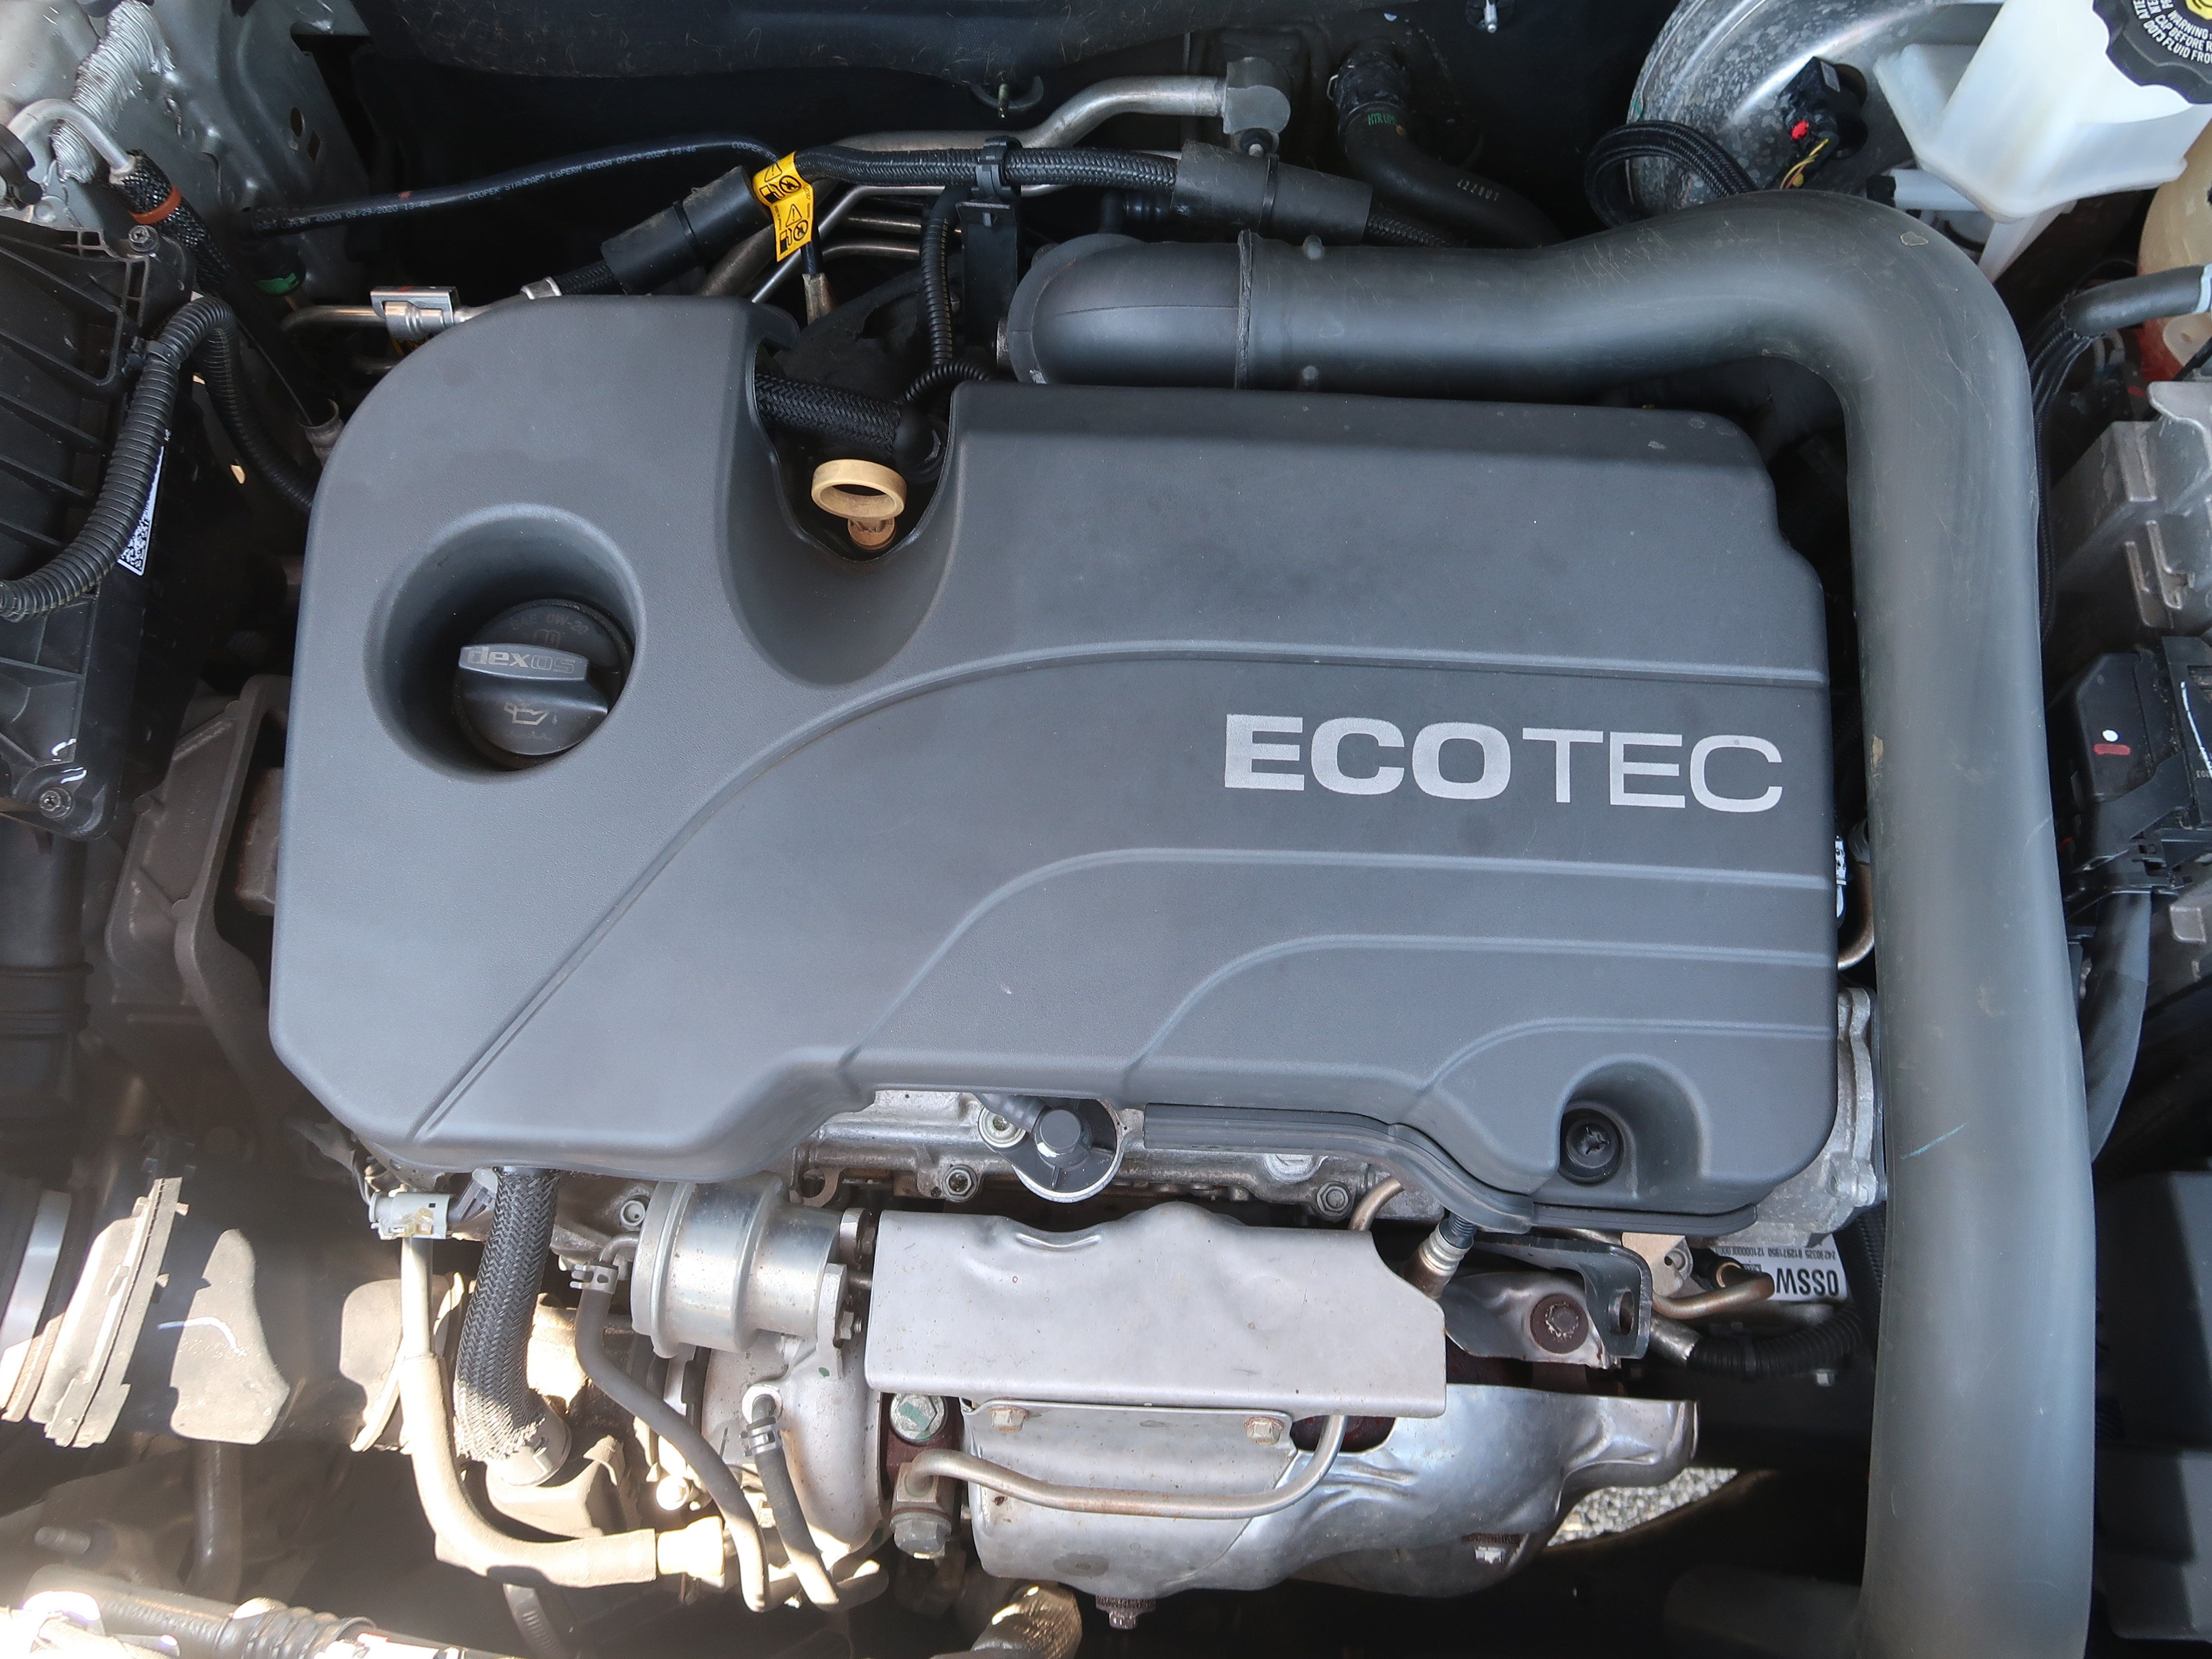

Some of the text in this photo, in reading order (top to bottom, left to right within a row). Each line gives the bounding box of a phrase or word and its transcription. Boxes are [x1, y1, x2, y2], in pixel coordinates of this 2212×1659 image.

[2143, 20, 2166, 42] DOT3
[2162, 37, 2191, 58] FLUID
[2168, 27, 2205, 51] BEFORE
[468, 186, 501, 200] COOPER
[468, 646, 575, 674] dexos
[1225, 714, 1783, 813] ECOTEC
